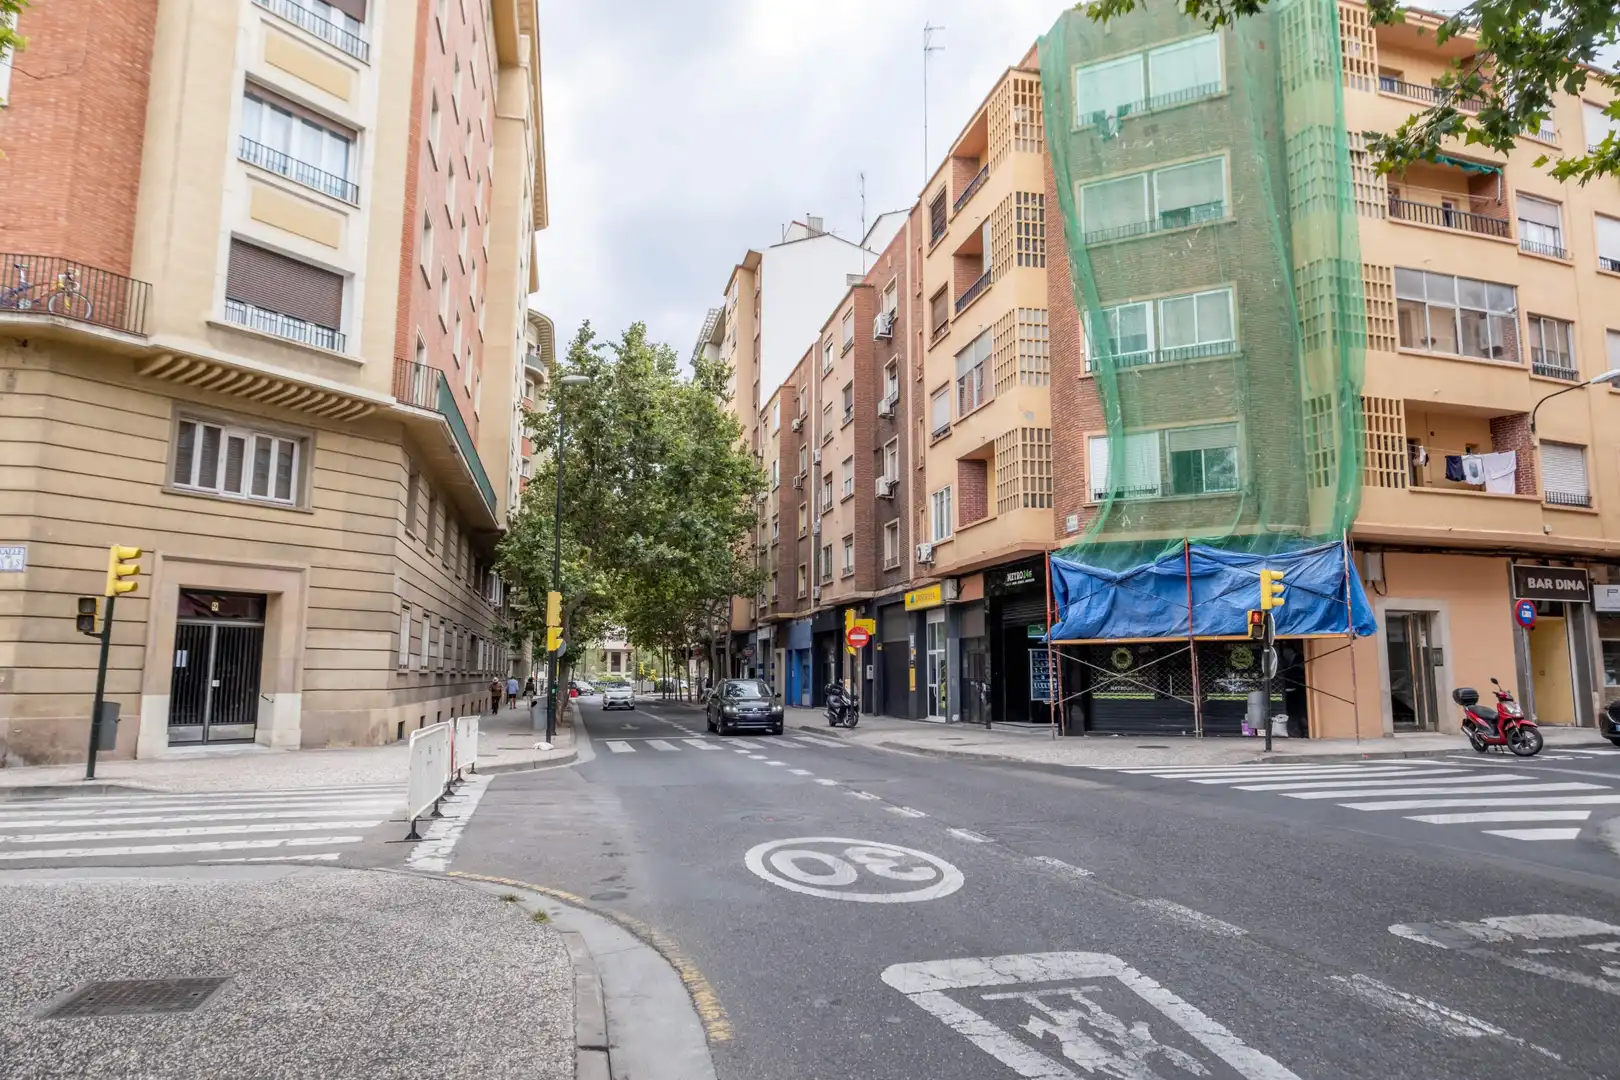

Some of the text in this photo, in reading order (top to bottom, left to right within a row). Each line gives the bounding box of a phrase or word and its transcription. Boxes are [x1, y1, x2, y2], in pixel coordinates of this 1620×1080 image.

[1528, 578, 1585, 591] BAR DINA
[770, 847, 937, 886] 30
